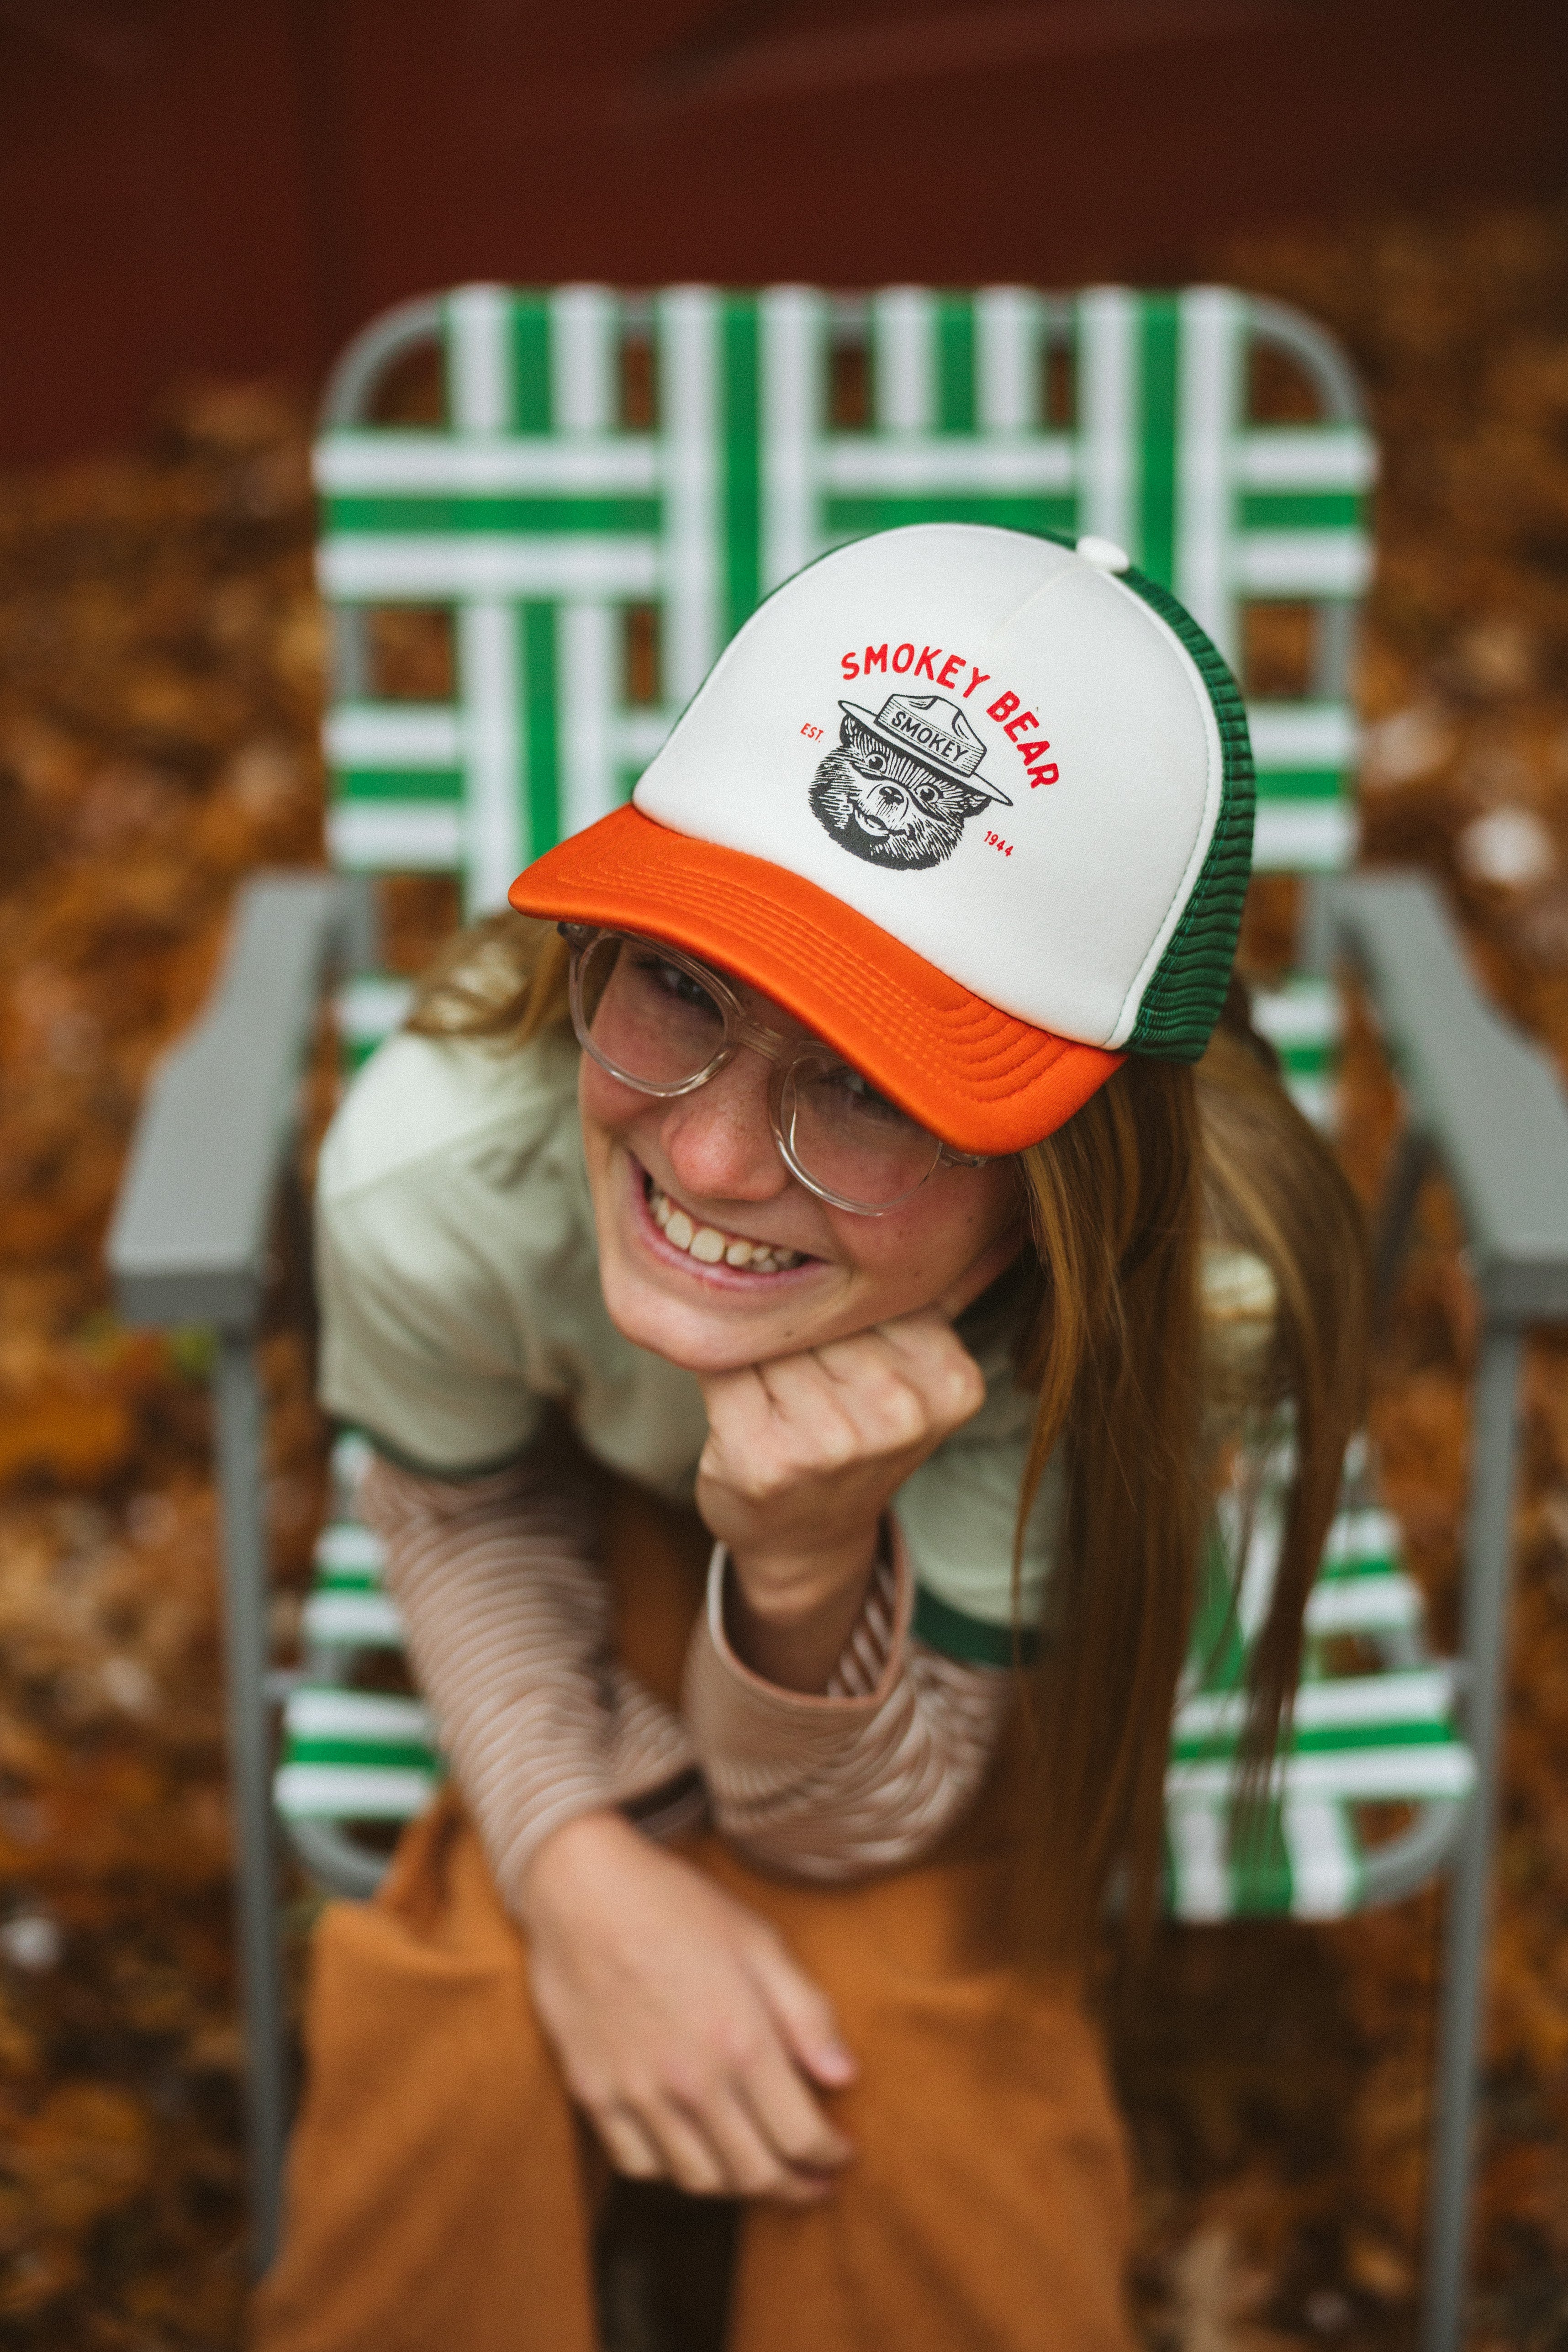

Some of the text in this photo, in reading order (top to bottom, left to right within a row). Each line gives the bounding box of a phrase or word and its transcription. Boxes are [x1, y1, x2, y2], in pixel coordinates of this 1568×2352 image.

[801, 723, 824, 742] EST.
[841, 643, 1059, 788] SMOKEY BEAR
[892, 711, 969, 761] SMOKEY
[984, 831, 1014, 856] 1944
